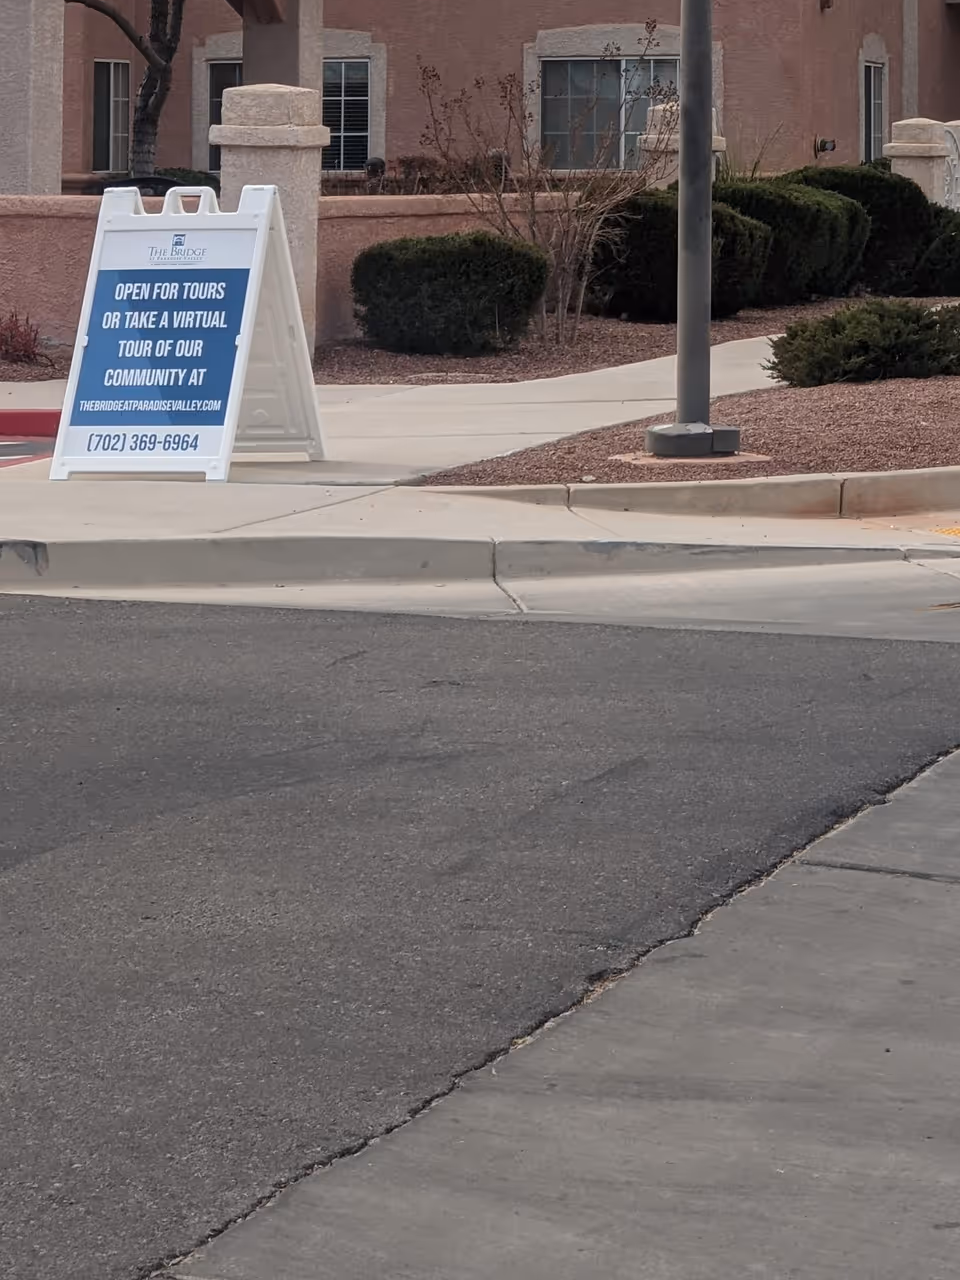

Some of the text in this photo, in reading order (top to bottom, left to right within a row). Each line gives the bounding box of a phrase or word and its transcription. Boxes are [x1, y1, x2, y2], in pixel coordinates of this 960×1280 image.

[147, 246, 208, 257] THE BRIDGE
[114, 282, 226, 300] OPEN FOR TOURS
[101, 310, 228, 329] OR TAKE A VIRTUAL
[118, 339, 203, 358] TOUR OF OUR
[103, 368, 207, 386] COMMUNITY AT
[79, 399, 222, 412] THEBRIDGEATPARADISEVALLEY.COM
[87, 433, 200, 453] (702) 369-6964
